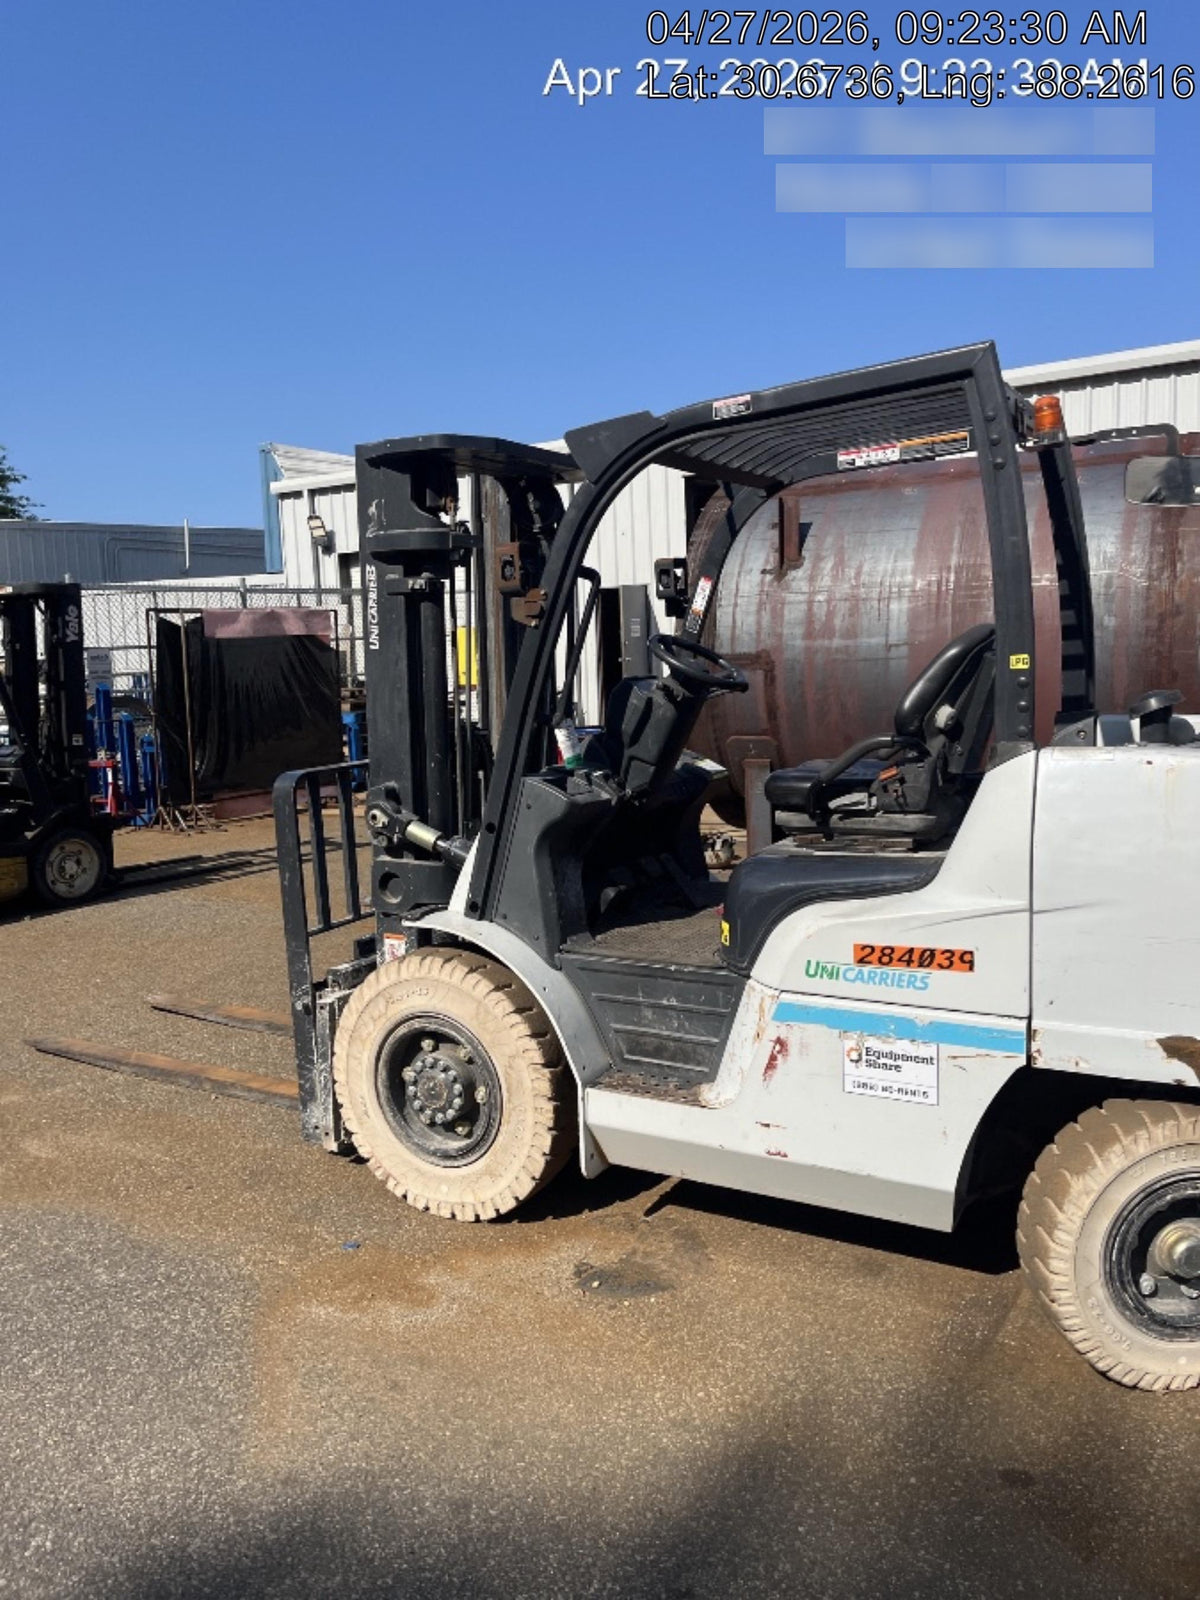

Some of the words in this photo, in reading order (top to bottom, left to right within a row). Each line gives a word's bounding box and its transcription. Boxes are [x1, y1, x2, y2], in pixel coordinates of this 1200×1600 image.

[65, 605, 79, 642] Yale
[1011, 656, 1029, 667] LPG
[857, 945, 974, 971] 284039
[865, 1047, 935, 1066] Equipment
[865, 1058, 902, 1073] Share
